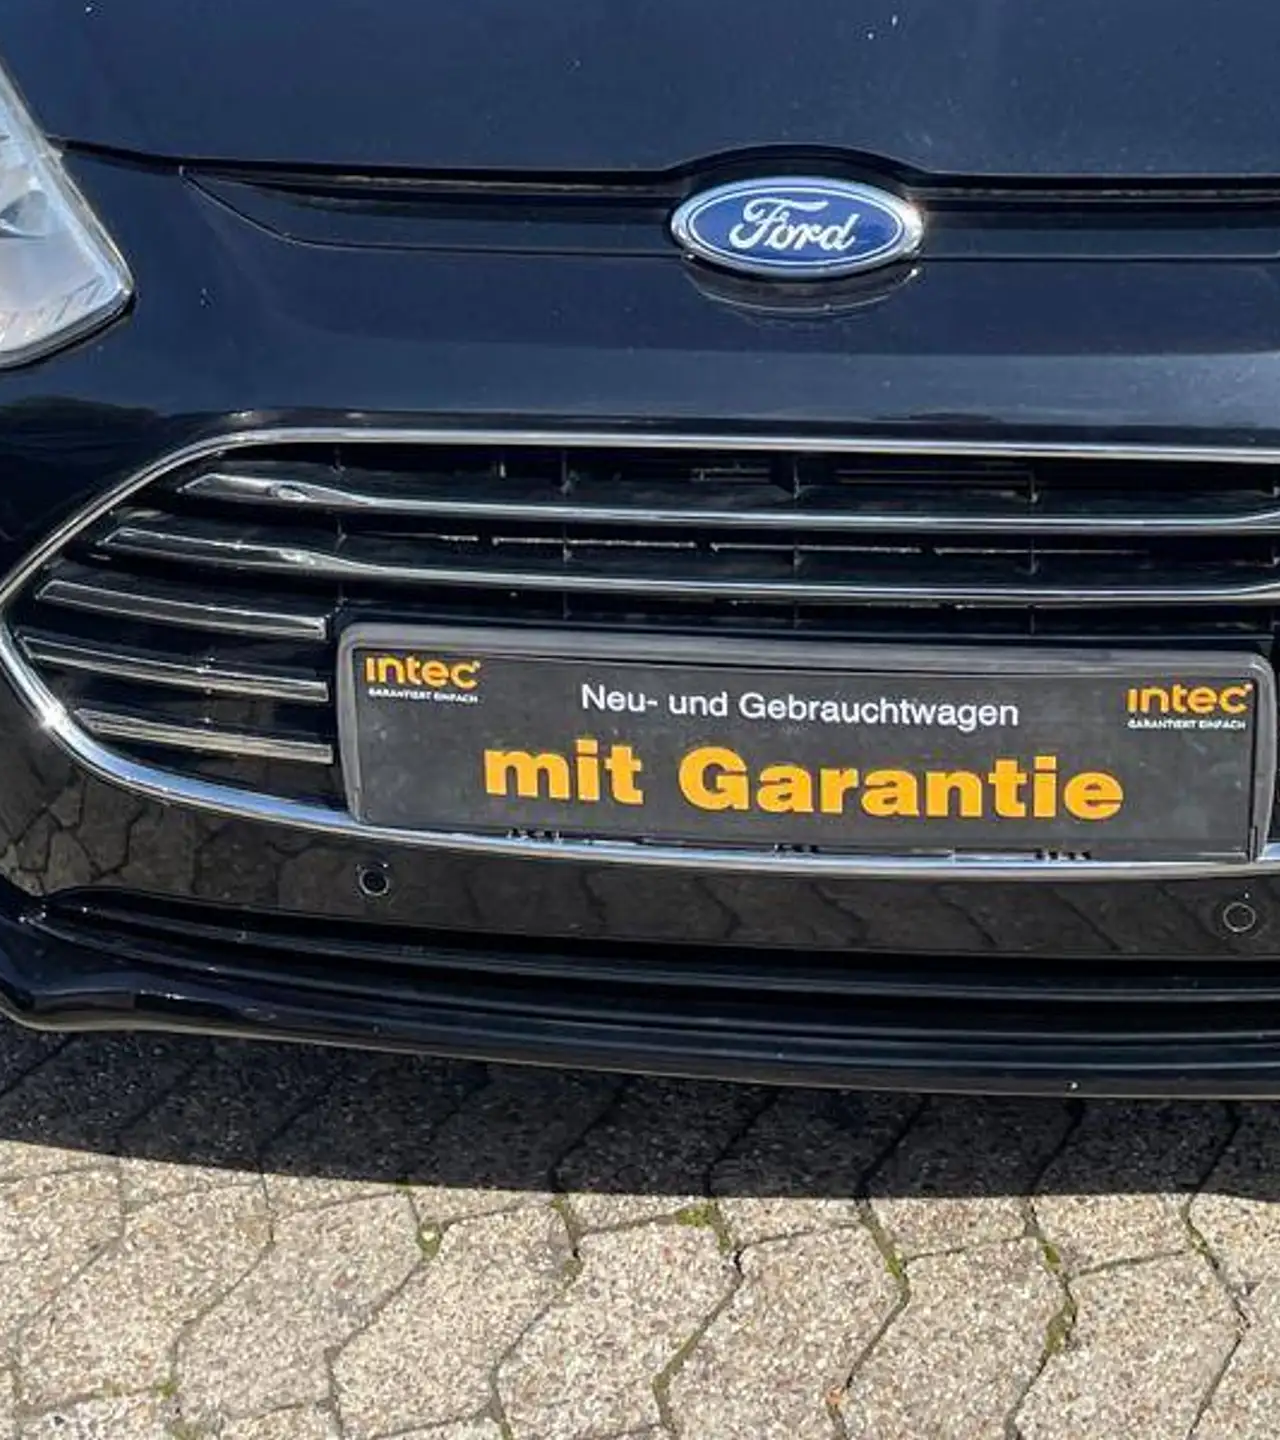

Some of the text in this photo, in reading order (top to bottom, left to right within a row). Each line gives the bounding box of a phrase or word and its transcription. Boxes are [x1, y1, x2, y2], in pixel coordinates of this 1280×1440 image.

[728, 197, 860, 251] Ford
[365, 655, 479, 689] intec
[581, 683, 1019, 732] Neu- und Gebrauchtwagen
[1127, 684, 1248, 714] intec
[484, 738, 1124, 820] mit Garantie
